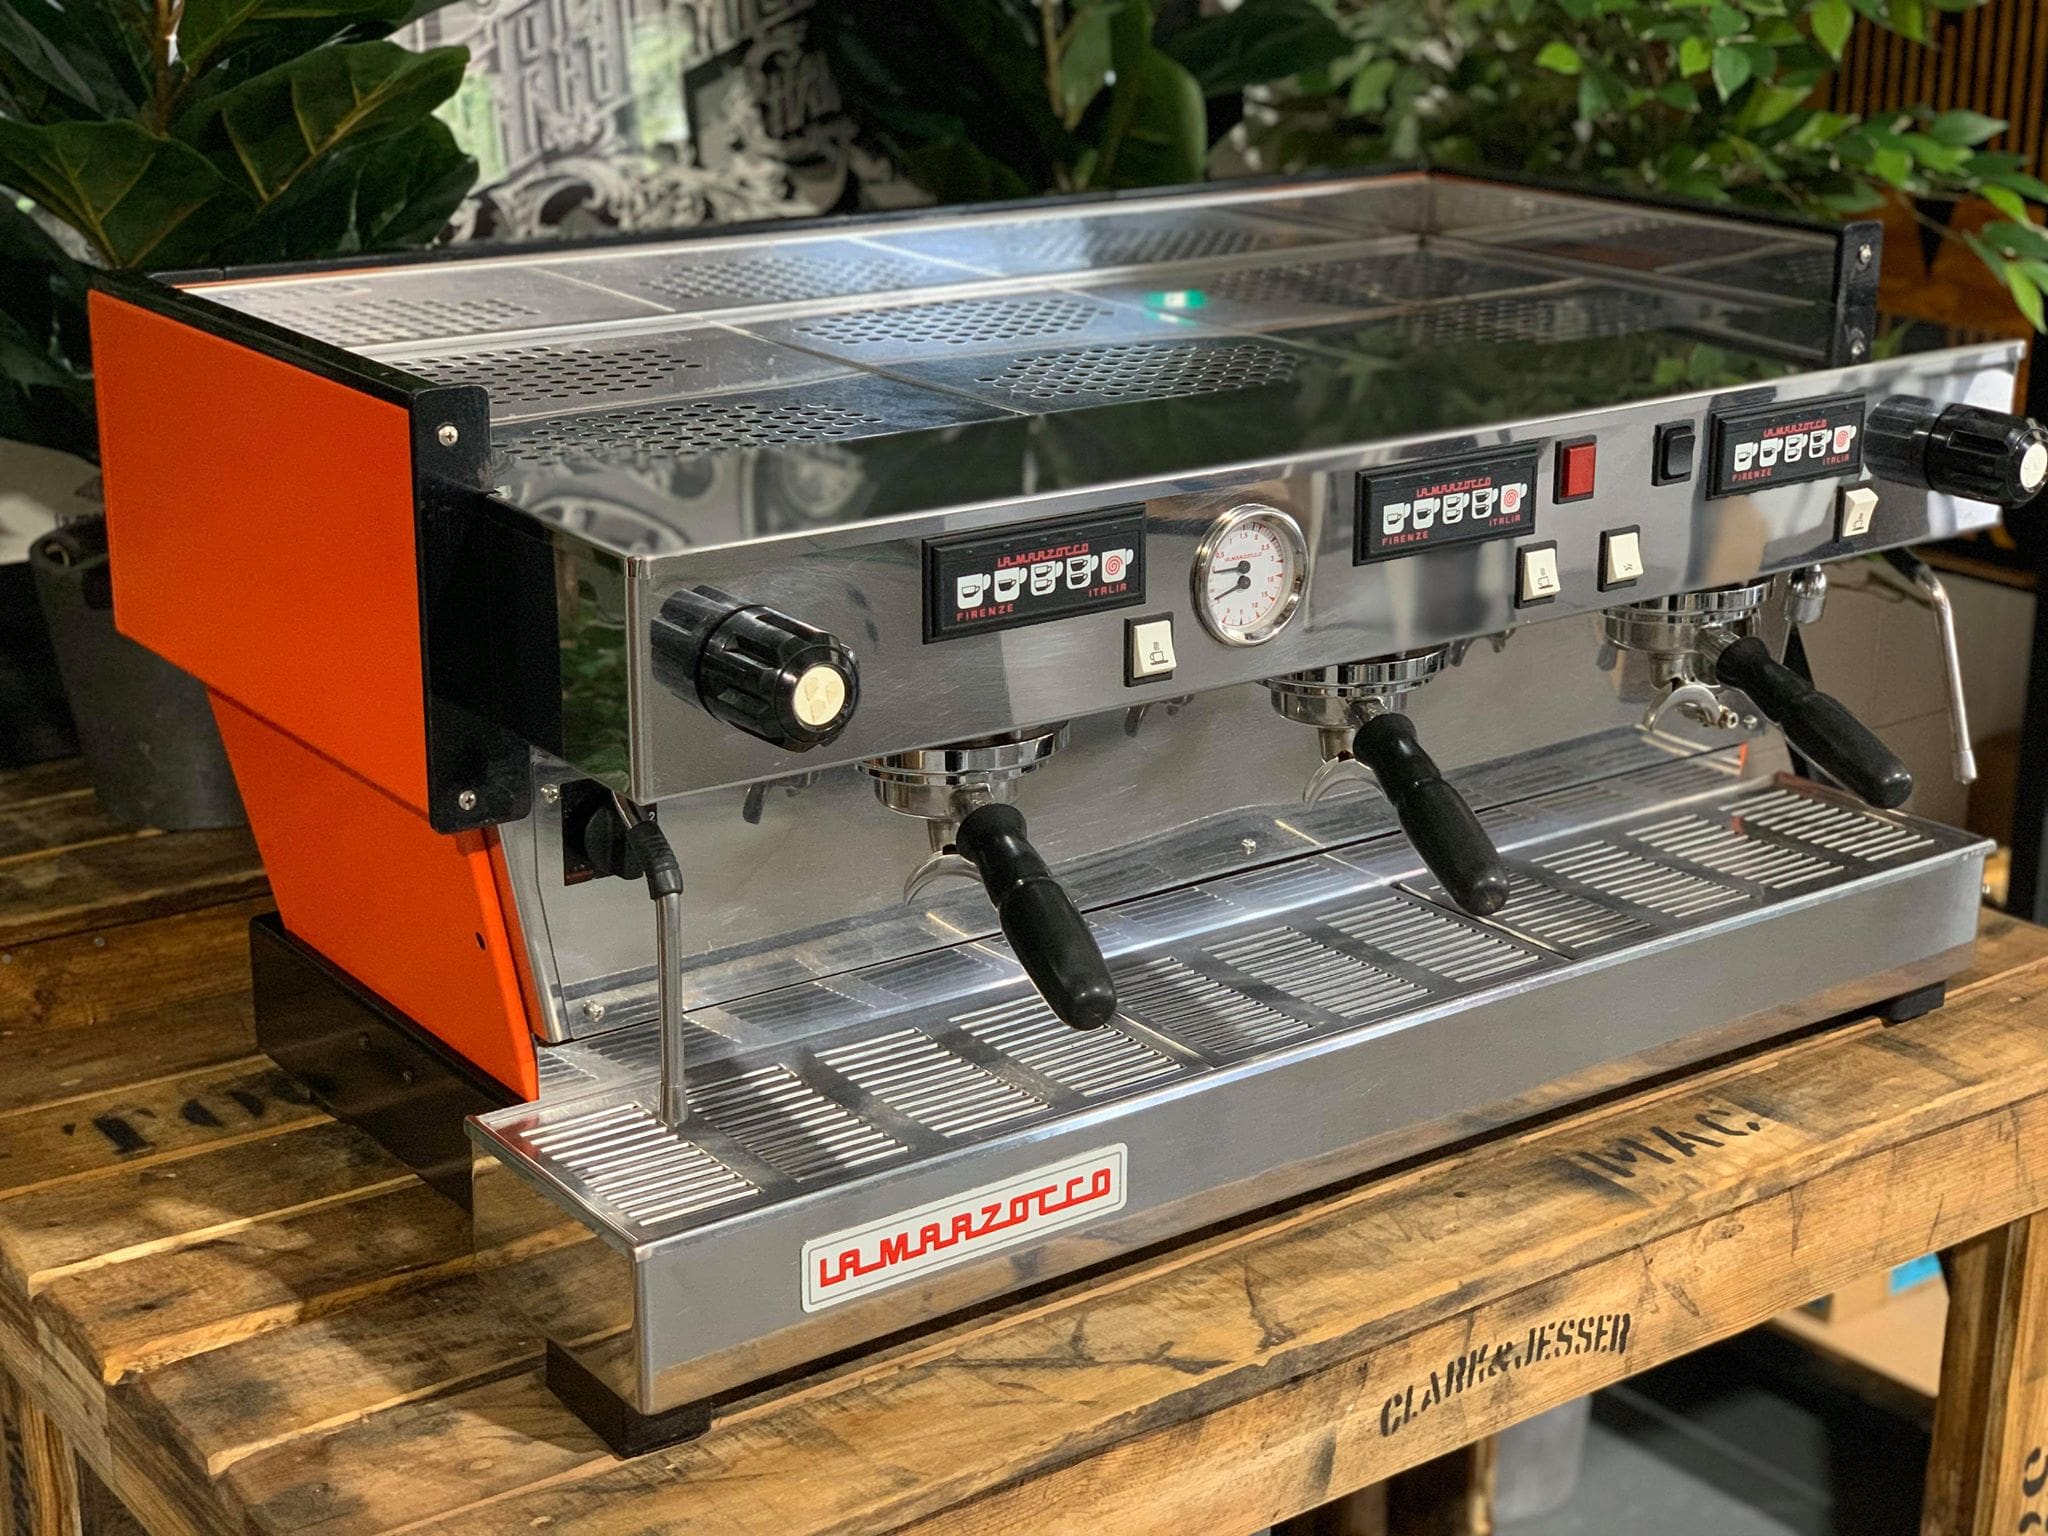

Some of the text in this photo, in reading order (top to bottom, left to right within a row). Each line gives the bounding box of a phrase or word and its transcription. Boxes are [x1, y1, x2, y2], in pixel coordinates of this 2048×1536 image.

[1822, 454, 1850, 466] ITALIA
[1732, 468, 1773, 483] FIRENZE
[1488, 514, 1521, 527] ITALIA
[1382, 530, 1429, 546] FIRENZE
[1088, 581, 1128, 598] ITALIA
[956, 603, 1015, 622] FIRENZE
[819, 1167, 1112, 1289] LA MARZOCCO
